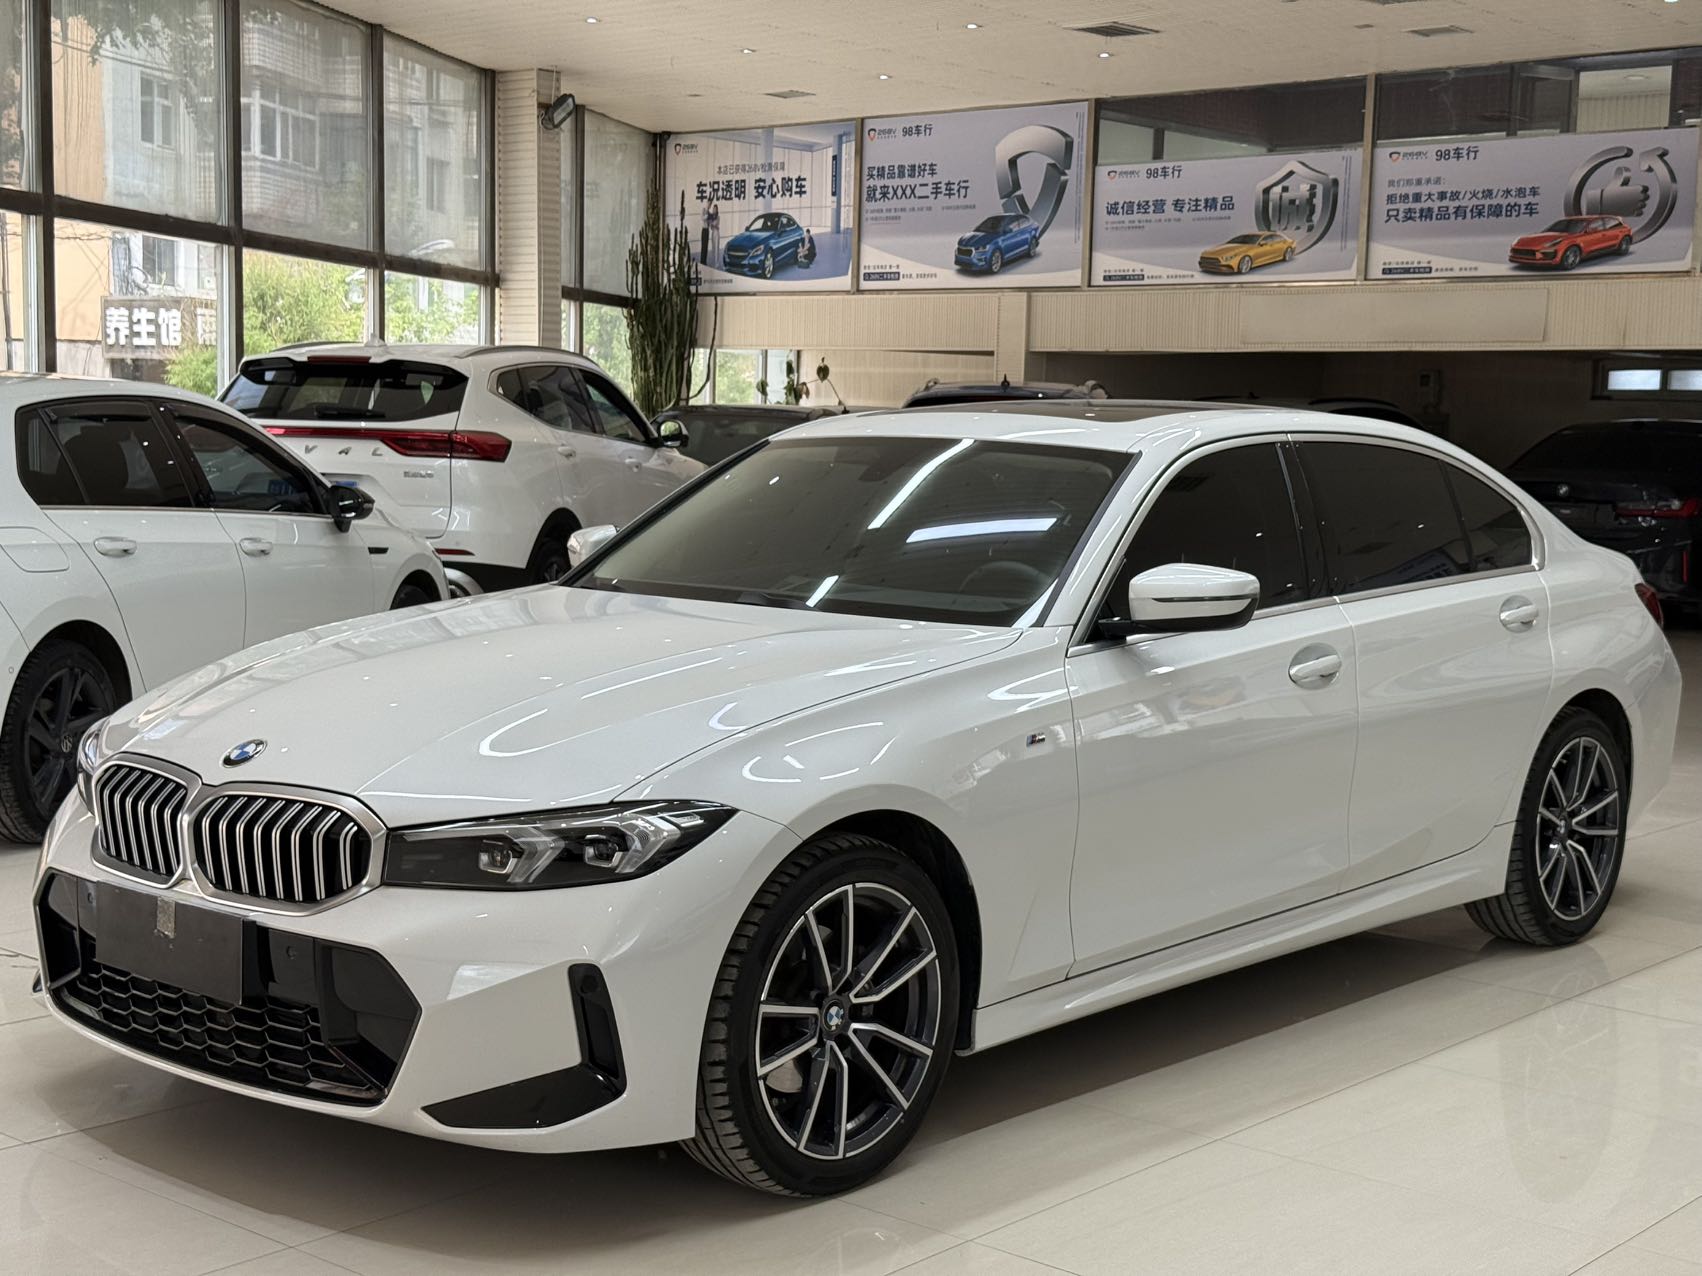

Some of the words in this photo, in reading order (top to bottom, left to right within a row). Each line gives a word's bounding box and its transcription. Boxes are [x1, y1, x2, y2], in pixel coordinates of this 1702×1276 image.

[902, 124, 934, 138] 98车行
[1435, 145, 1480, 162] 98车行
[865, 162, 938, 182] 买精品靠谱好车
[1145, 165, 1183, 180] 98车行
[695, 178, 747, 203] 车况透明
[753, 175, 807, 200] 安心购车
[865, 179, 970, 204] 就来XXX二手车行
[1386, 186, 1541, 206] 拒绝重大事故/火烧/水泡车
[1105, 199, 1167, 217] 诚信经营
[1171, 195, 1235, 214] 专注精品
[1384, 202, 1540, 224] 只卖精品有保障的车
[105, 306, 182, 346] 养生馆
